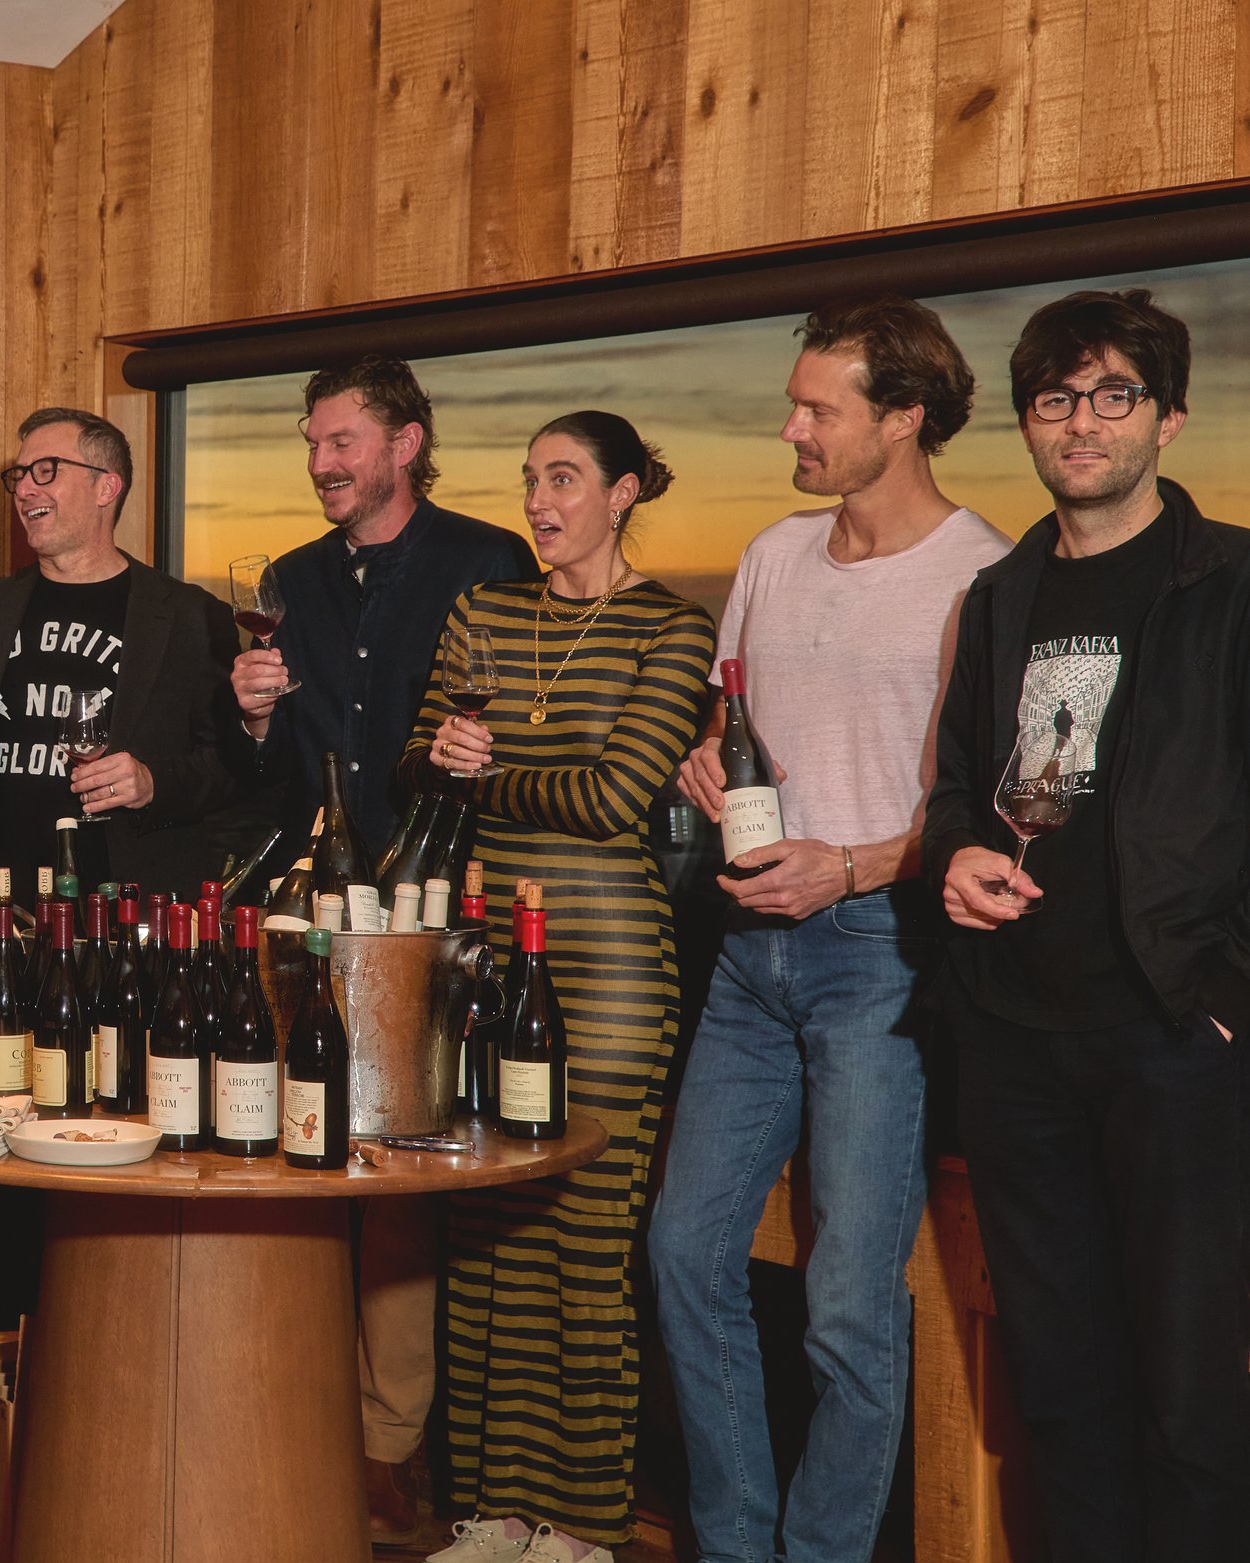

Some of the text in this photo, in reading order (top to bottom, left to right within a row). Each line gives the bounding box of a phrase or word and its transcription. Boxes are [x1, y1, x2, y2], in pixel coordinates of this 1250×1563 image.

[40, 621, 123, 674] GRIT
[1031, 636, 1119, 661] FRANZ KAFKA
[25, 683, 72, 718] NO
[1020, 773, 1084, 794] PRAGUE
[726, 799, 766, 814] ABBOTT
[732, 823, 766, 835] CLAIM
[225, 1076, 268, 1087] ABBOTT
[150, 1096, 177, 1108] CLAIM
[229, 1104, 263, 1114] CLAIM
